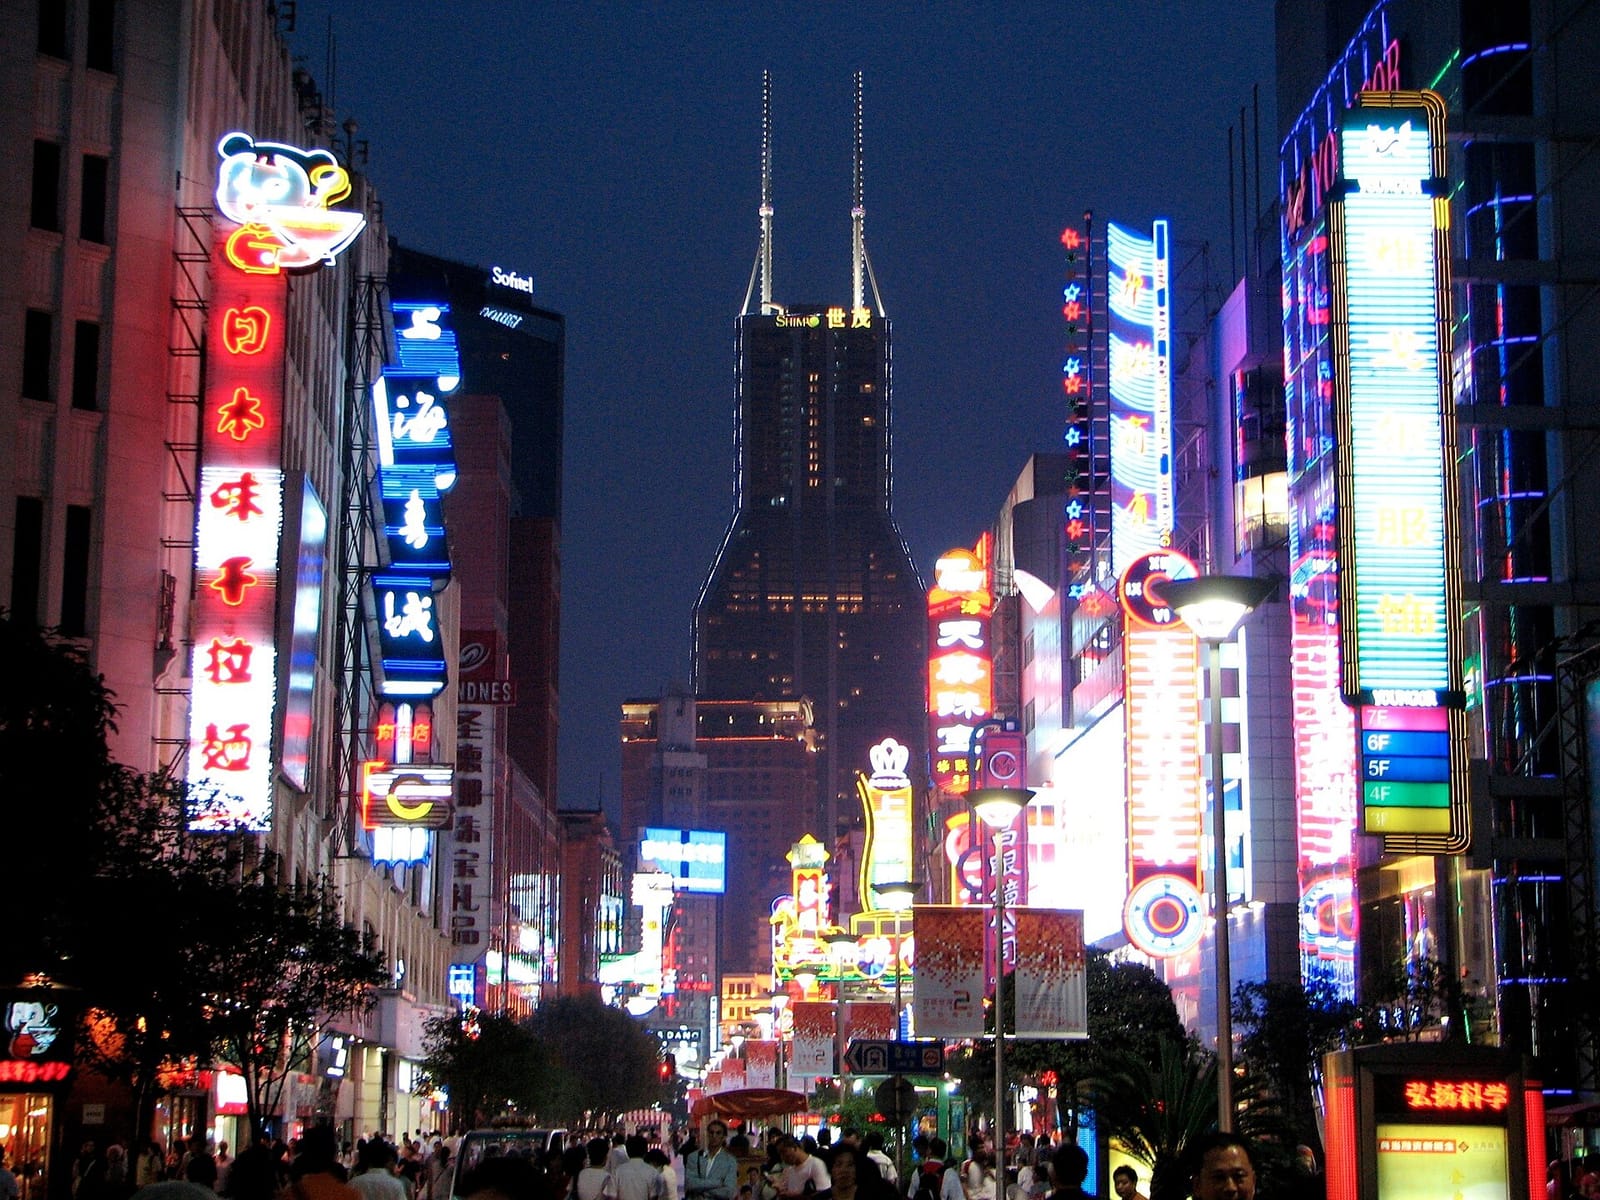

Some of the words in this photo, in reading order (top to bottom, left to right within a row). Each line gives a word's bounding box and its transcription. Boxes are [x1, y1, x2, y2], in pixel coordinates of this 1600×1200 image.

[492, 266, 533, 293] Sofitel
[826, 307, 872, 329] 世茂
[1153, 608, 1171, 623] VI
[1366, 709, 1389, 728] 7F
[1366, 733, 1391, 752] 6F
[1368, 759, 1391, 777] 5F
[1369, 785, 1392, 801] 4F
[953, 989, 970, 1011] 2
[1405, 1080, 1509, 1111] 弘扬科学
